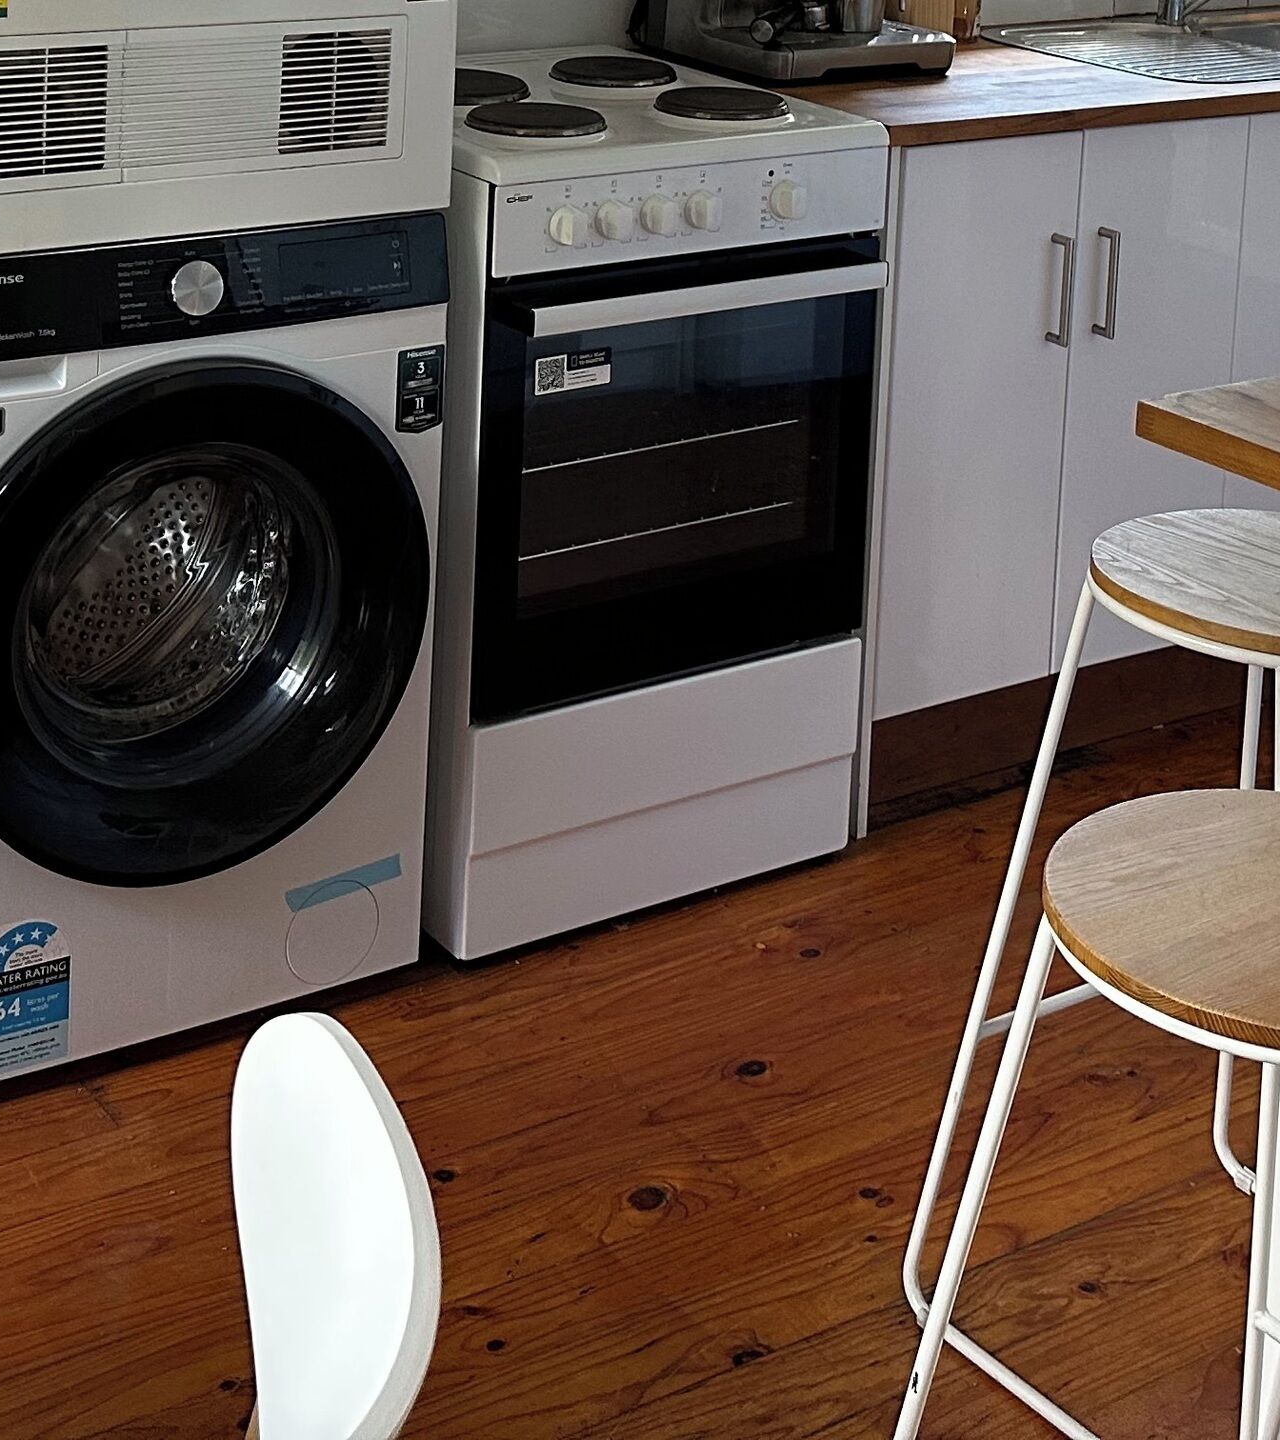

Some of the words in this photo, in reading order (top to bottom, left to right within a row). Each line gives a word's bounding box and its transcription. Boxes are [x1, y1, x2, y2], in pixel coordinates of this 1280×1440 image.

[406, 348, 437, 359] Hisense
[417, 362, 425, 374] 3
[415, 396, 425, 409] 11
[25, 960, 67, 980] RATING
